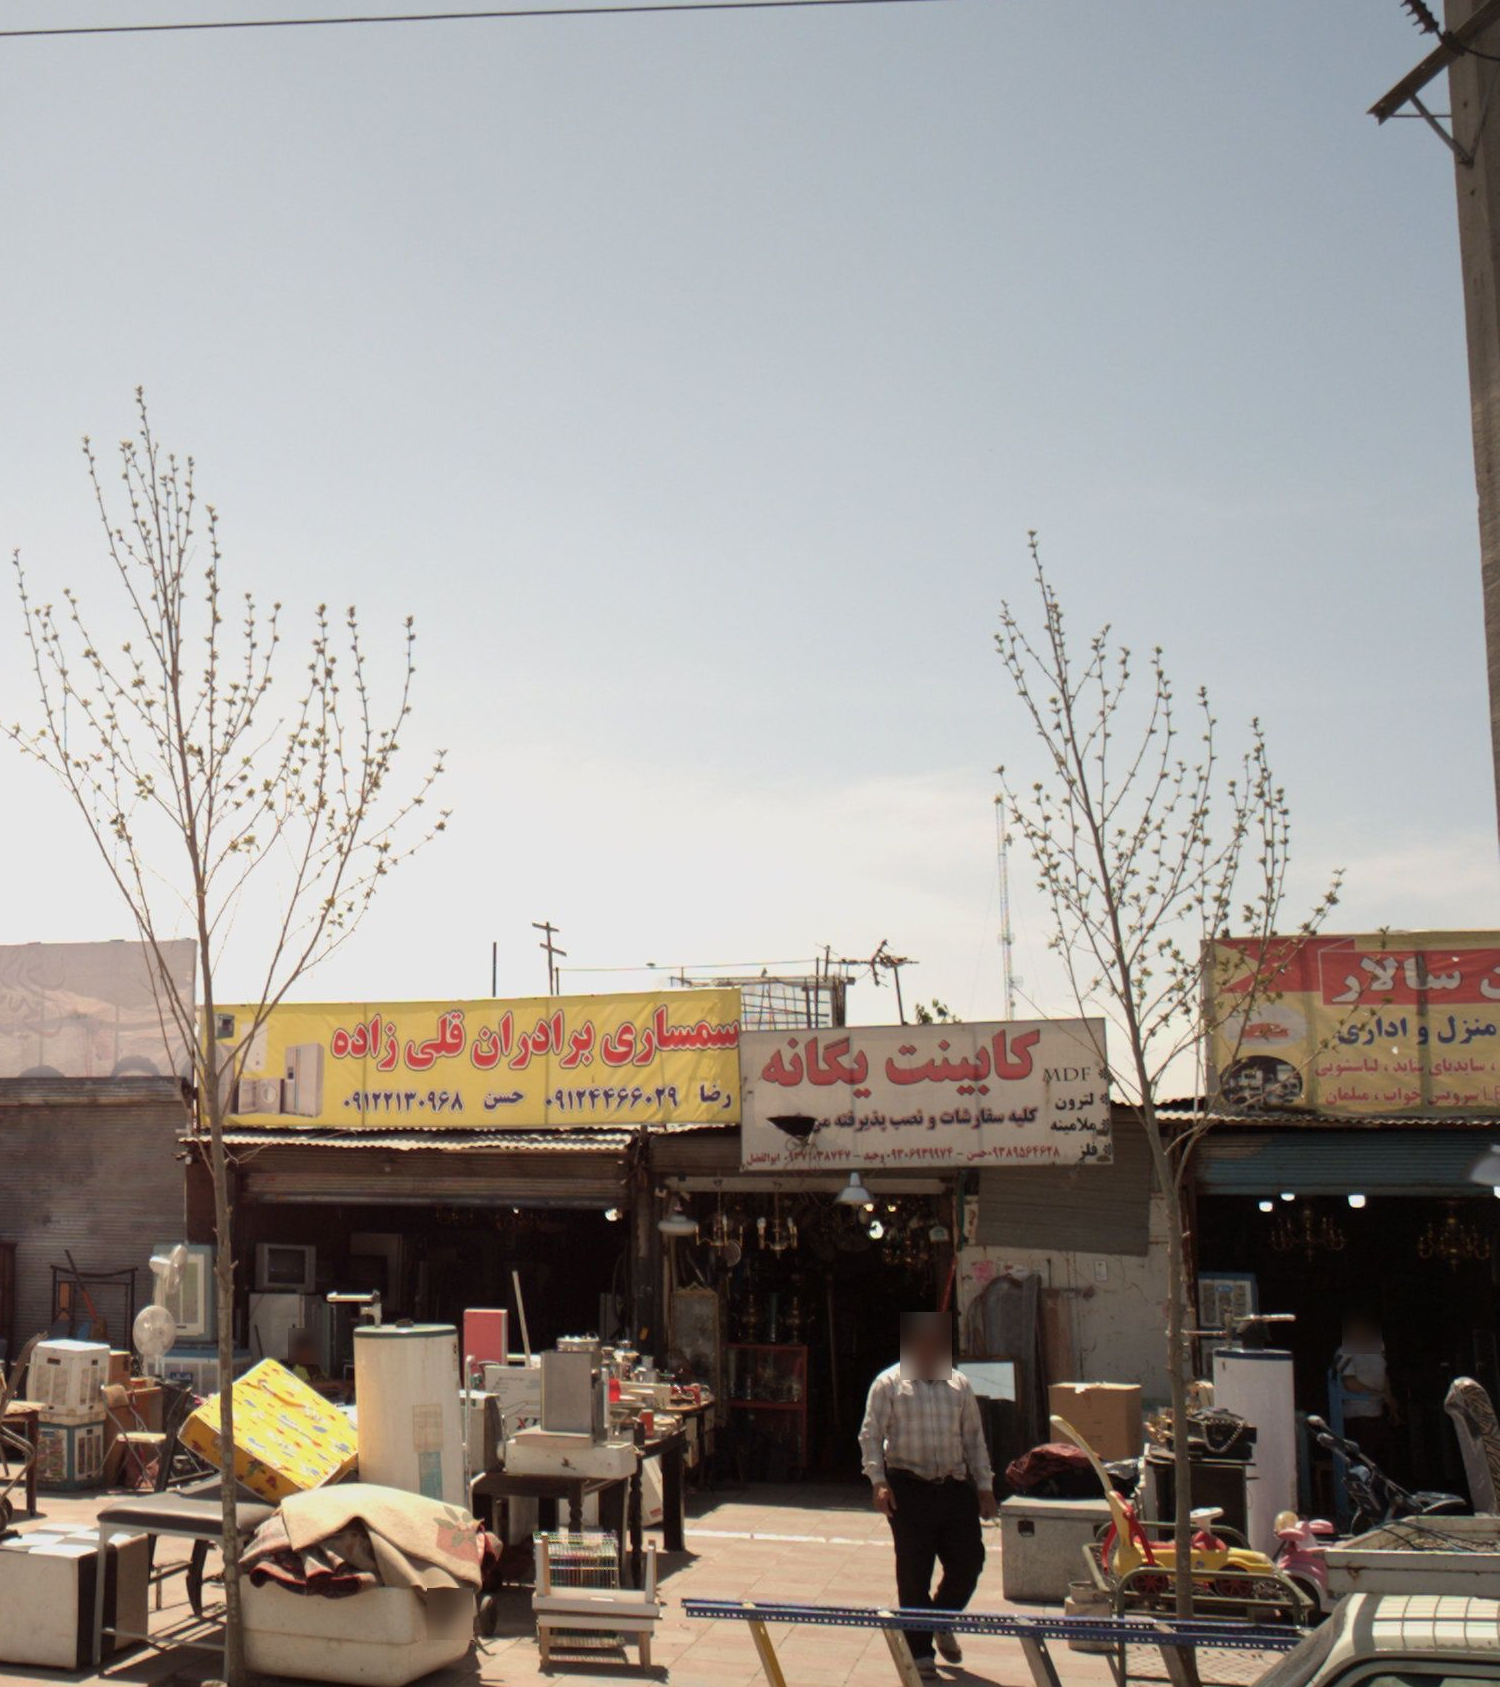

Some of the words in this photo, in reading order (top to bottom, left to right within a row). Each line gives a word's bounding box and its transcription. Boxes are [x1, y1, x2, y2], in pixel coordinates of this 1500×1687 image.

[1331, 956, 1462, 1003] سالار
[404, 1008, 466, 1070] قلی
[470, 1009, 596, 1070] برادران
[600, 1004, 740, 1066] سمساری
[1337, 1016, 1407, 1045] اداری
[1417, 1027, 1429, 1045] و
[1437, 1015, 1497, 1046] منزل
[331, 1014, 397, 1073] زاده
[762, 1037, 869, 1099] یگانه
[885, 1029, 1041, 1096] کابینت
[1044, 1066, 1091, 1082] MDF
[344, 1090, 463, 1112] ۰۹۱۲۲۱۳۰۹۶۸
[483, 1091, 525, 1110] حسن
[545, 1086, 678, 1111] ۰۹۱۲۴۴۶۶۰۲۹
[700, 1083, 732, 1109] رضا
[1055, 1092, 1094, 1111] لترون
[834, 1109, 887, 1132] پذیرفته
[889, 1109, 923, 1128] نصب
[928, 1116, 936, 1129] و
[940, 1107, 1004, 1129] سفارشات
[1009, 1106, 1038, 1128] کلیه
[1050, 1117, 1097, 1136] ملامینه
[1077, 1141, 1099, 1162] فلز
